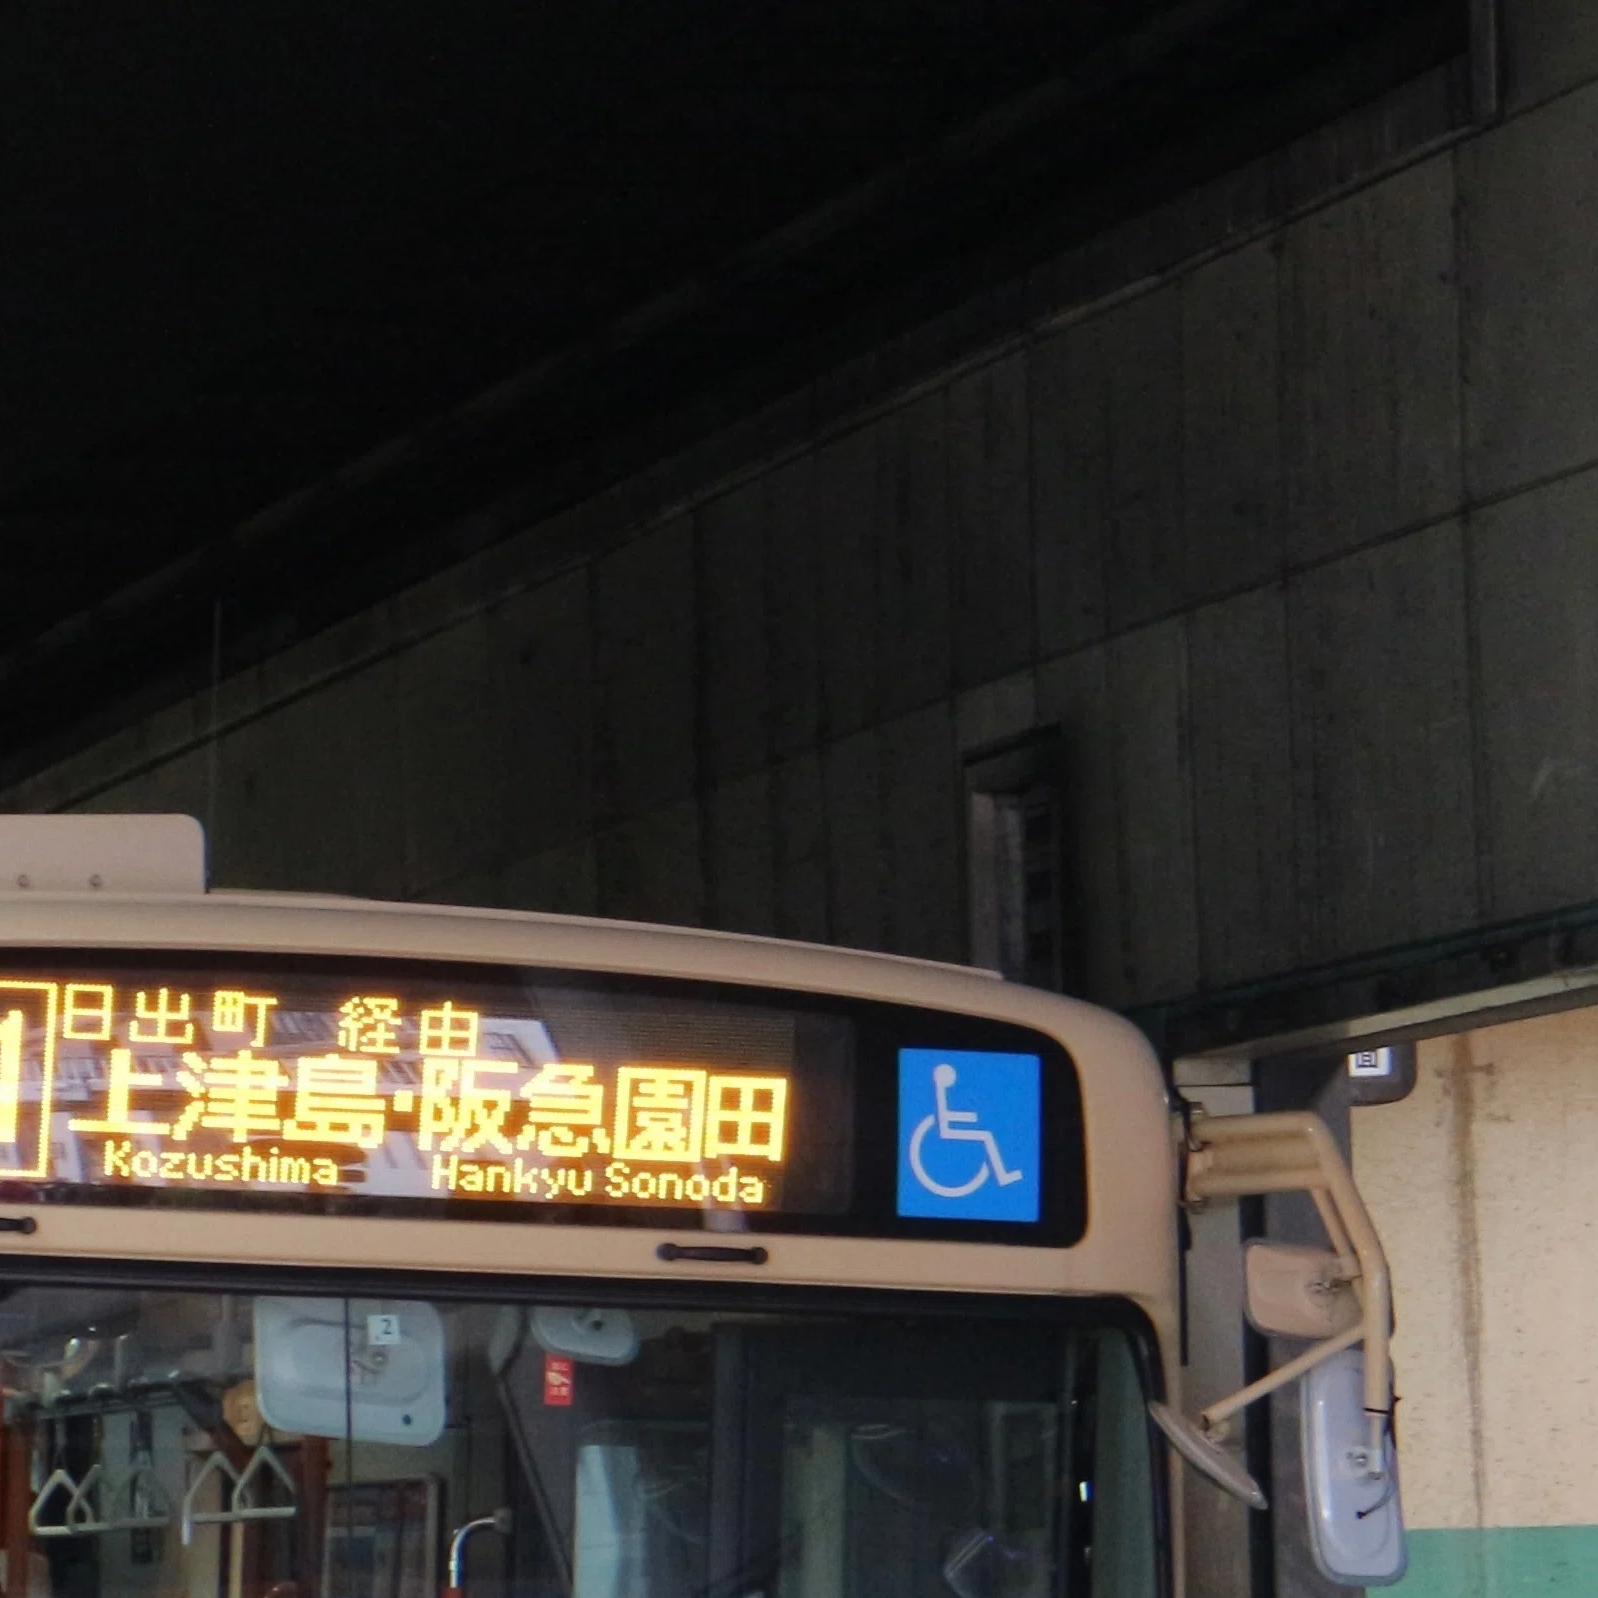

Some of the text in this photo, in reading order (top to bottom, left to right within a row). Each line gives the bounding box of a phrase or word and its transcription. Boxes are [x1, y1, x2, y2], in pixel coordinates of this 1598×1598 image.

[62, 982, 480, 1058] 日出町 経由
[103, 1139, 340, 1187] Kozushima
[430, 1153, 766, 1205] Hankyu Sonoda
